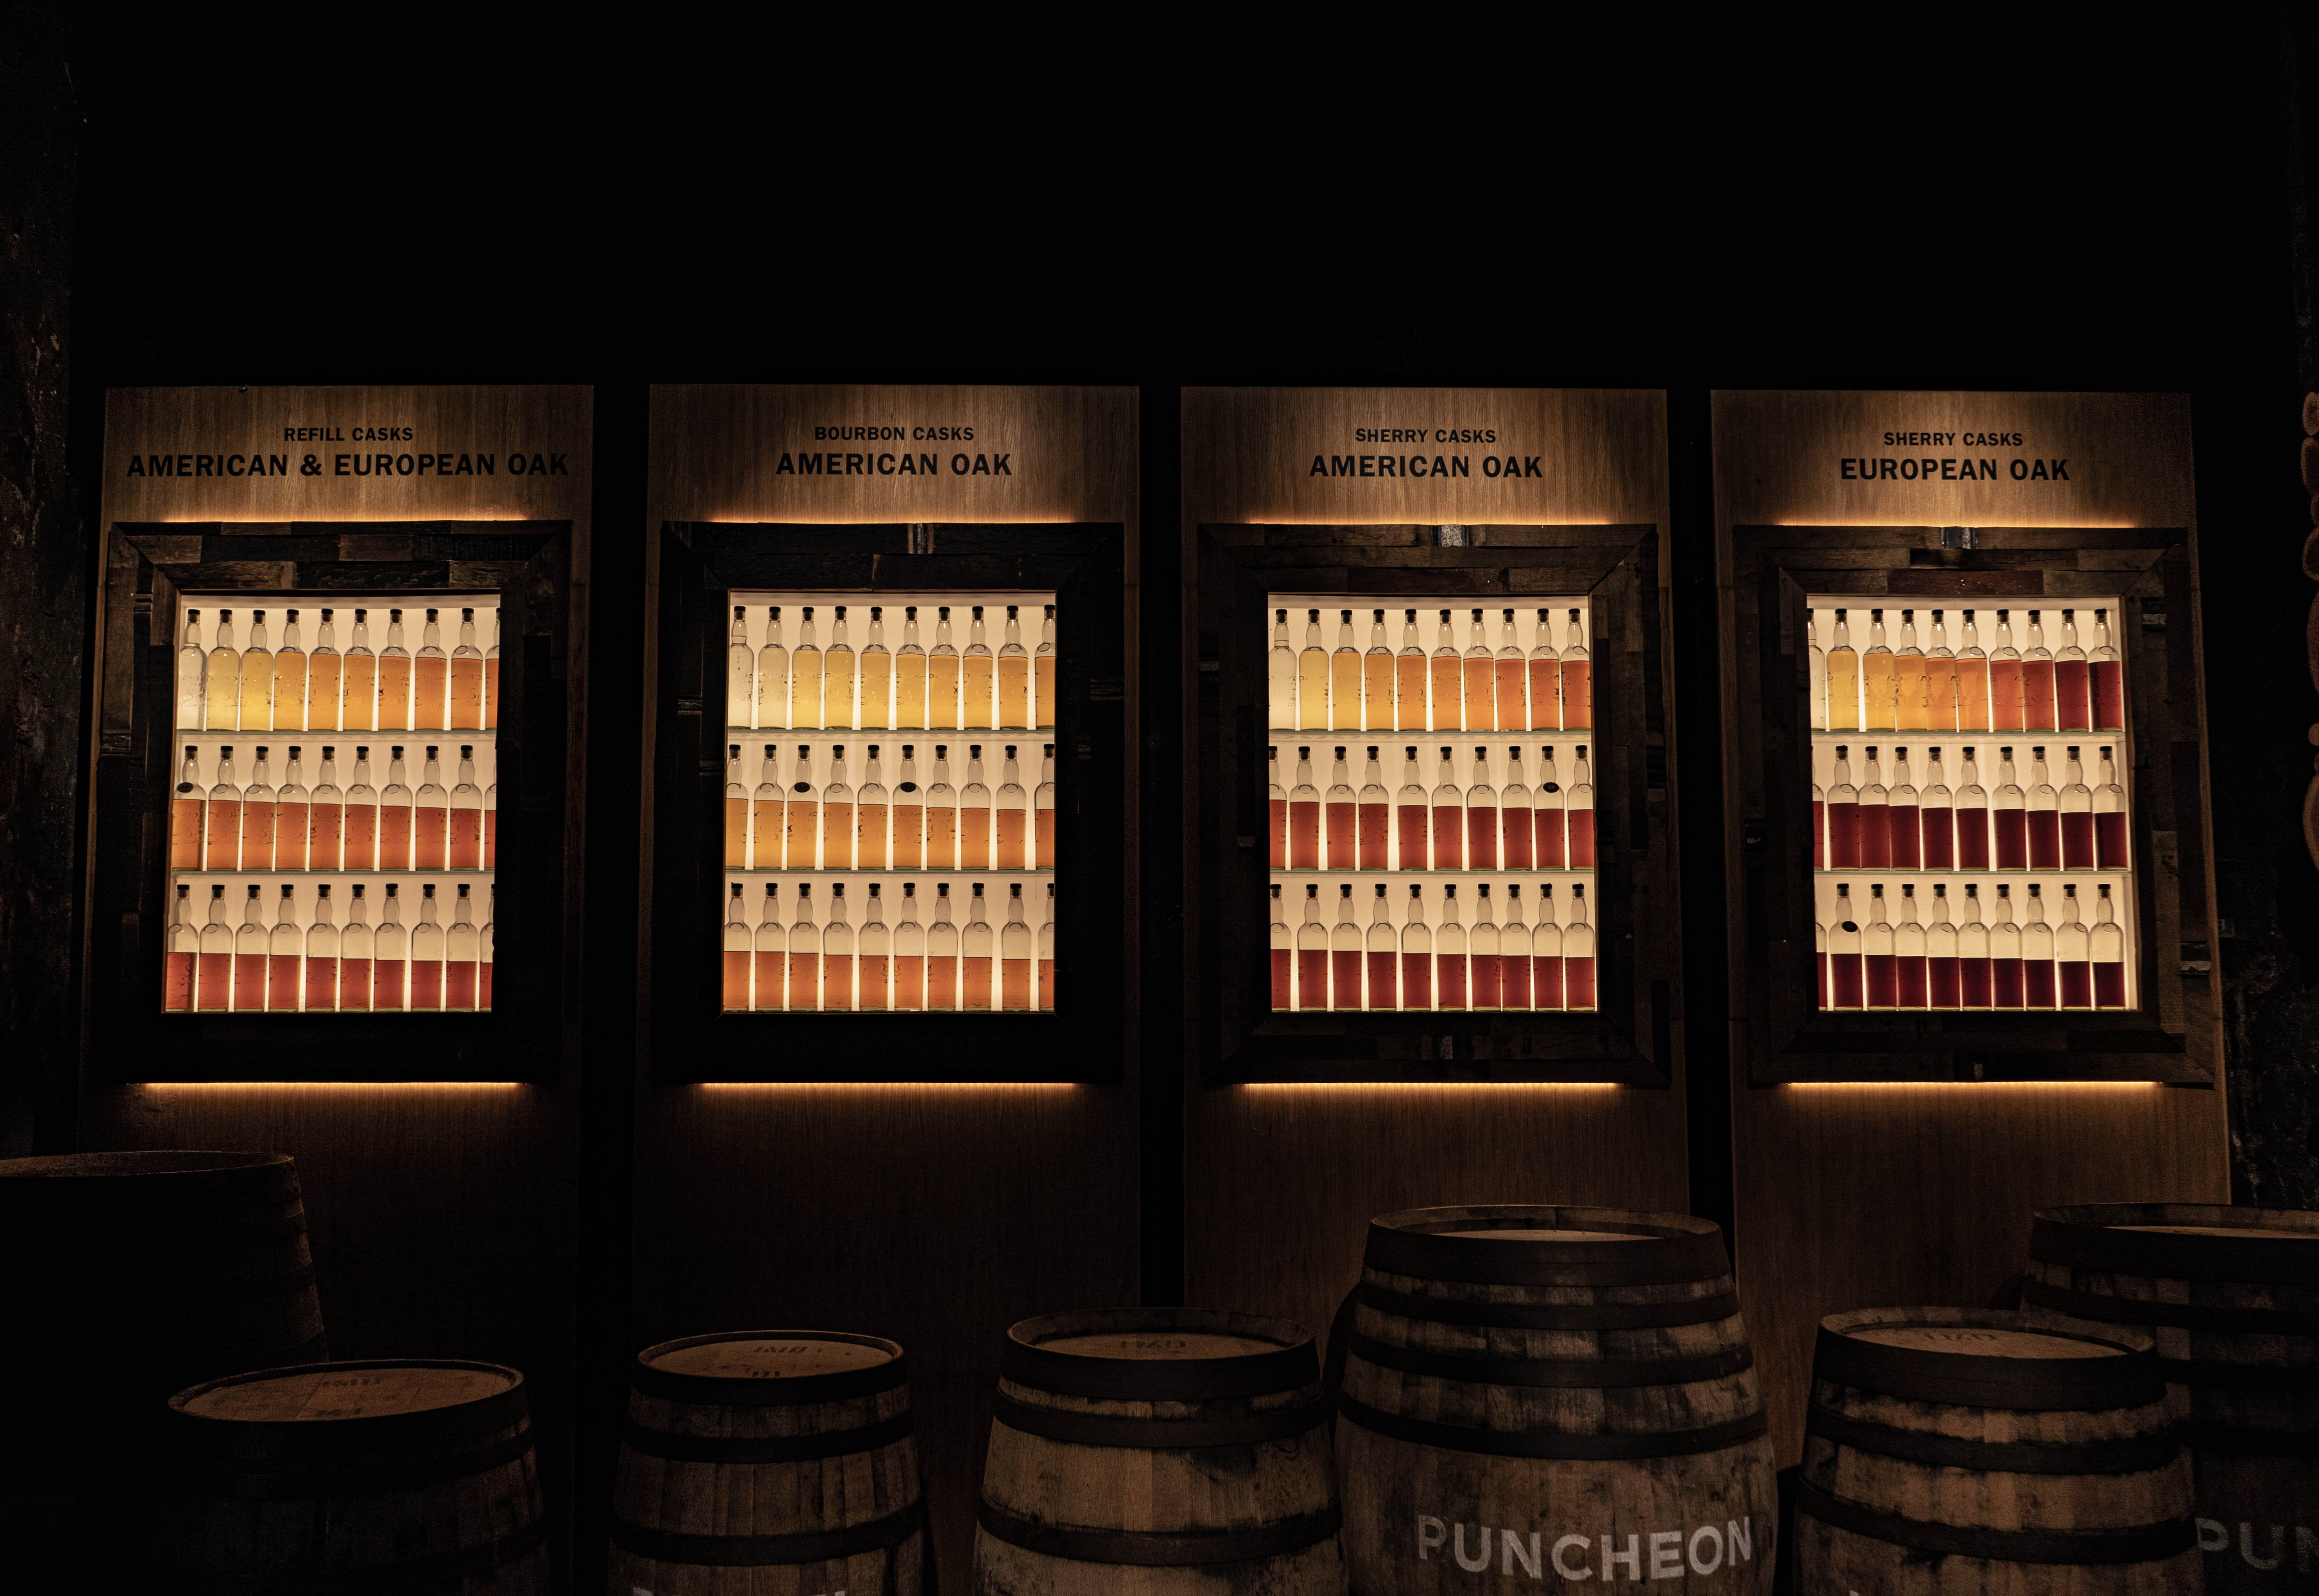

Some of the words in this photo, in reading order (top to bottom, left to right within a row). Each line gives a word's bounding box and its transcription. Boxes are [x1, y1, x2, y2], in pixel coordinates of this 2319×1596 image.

[285, 428, 344, 441] REFILL
[352, 427, 412, 441] CASKS
[815, 427, 904, 440] BOURBON
[913, 427, 974, 440] CASKS
[1356, 428, 1428, 442] SHERRY
[1436, 429, 1496, 443] CASKS
[1884, 432, 1955, 445] SHERRY
[1964, 433, 2023, 446] CASKS
[127, 455, 286, 477] AMERICAN
[300, 454, 321, 476] &
[335, 453, 495, 475] EUROPEAN
[508, 453, 568, 475] OAK
[776, 453, 937, 475] AMERICAN
[951, 454, 1011, 475] OAK
[1309, 455, 1468, 477] AMERICAN
[1483, 456, 1542, 477] OAK
[1841, 458, 1997, 480] EUROPEAN
[2011, 459, 2069, 480] OAK
[1418, 1514, 1750, 1581] PUNCHEON
